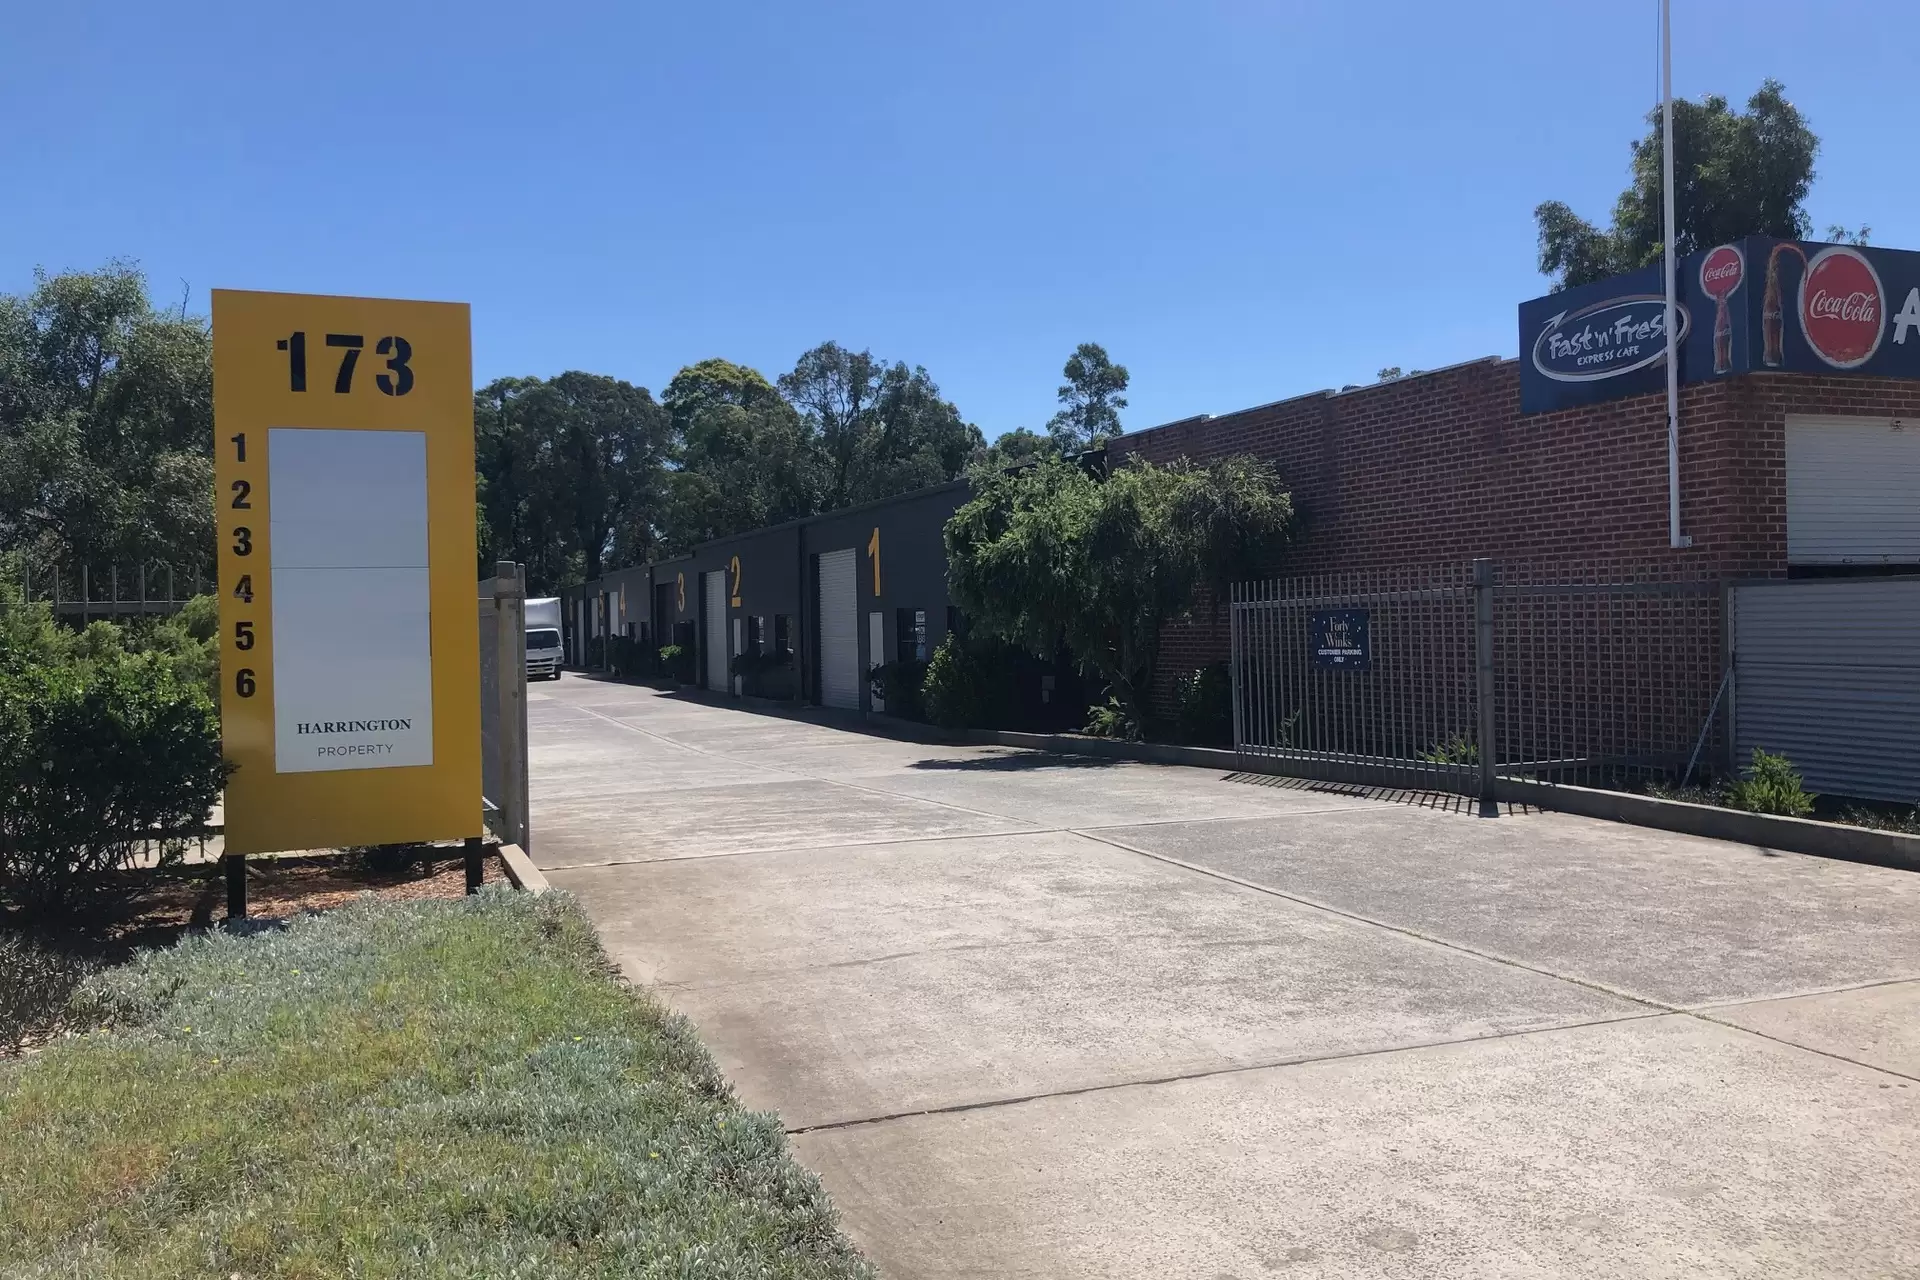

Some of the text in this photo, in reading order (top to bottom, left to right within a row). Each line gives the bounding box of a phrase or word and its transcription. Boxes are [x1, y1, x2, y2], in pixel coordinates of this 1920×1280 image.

[1810, 289, 1877, 322] Coca-Cola
[276, 331, 414, 396] 173
[1577, 345, 1640, 365] EXPRESS CAFE
[231, 433, 246, 462] 1
[231, 480, 251, 509] 2
[232, 527, 252, 556] 3
[868, 527, 881, 597] 1
[233, 575, 254, 603] 4
[678, 572, 685, 612] 3
[731, 556, 741, 608] 2
[235, 621, 254, 650] 5
[1329, 616, 1350, 632] Forty
[1325, 632, 1352, 647] Winks
[236, 668, 255, 698] 6
[297, 718, 412, 735] HARRINGTON
[317, 743, 394, 757] PROPERTY
